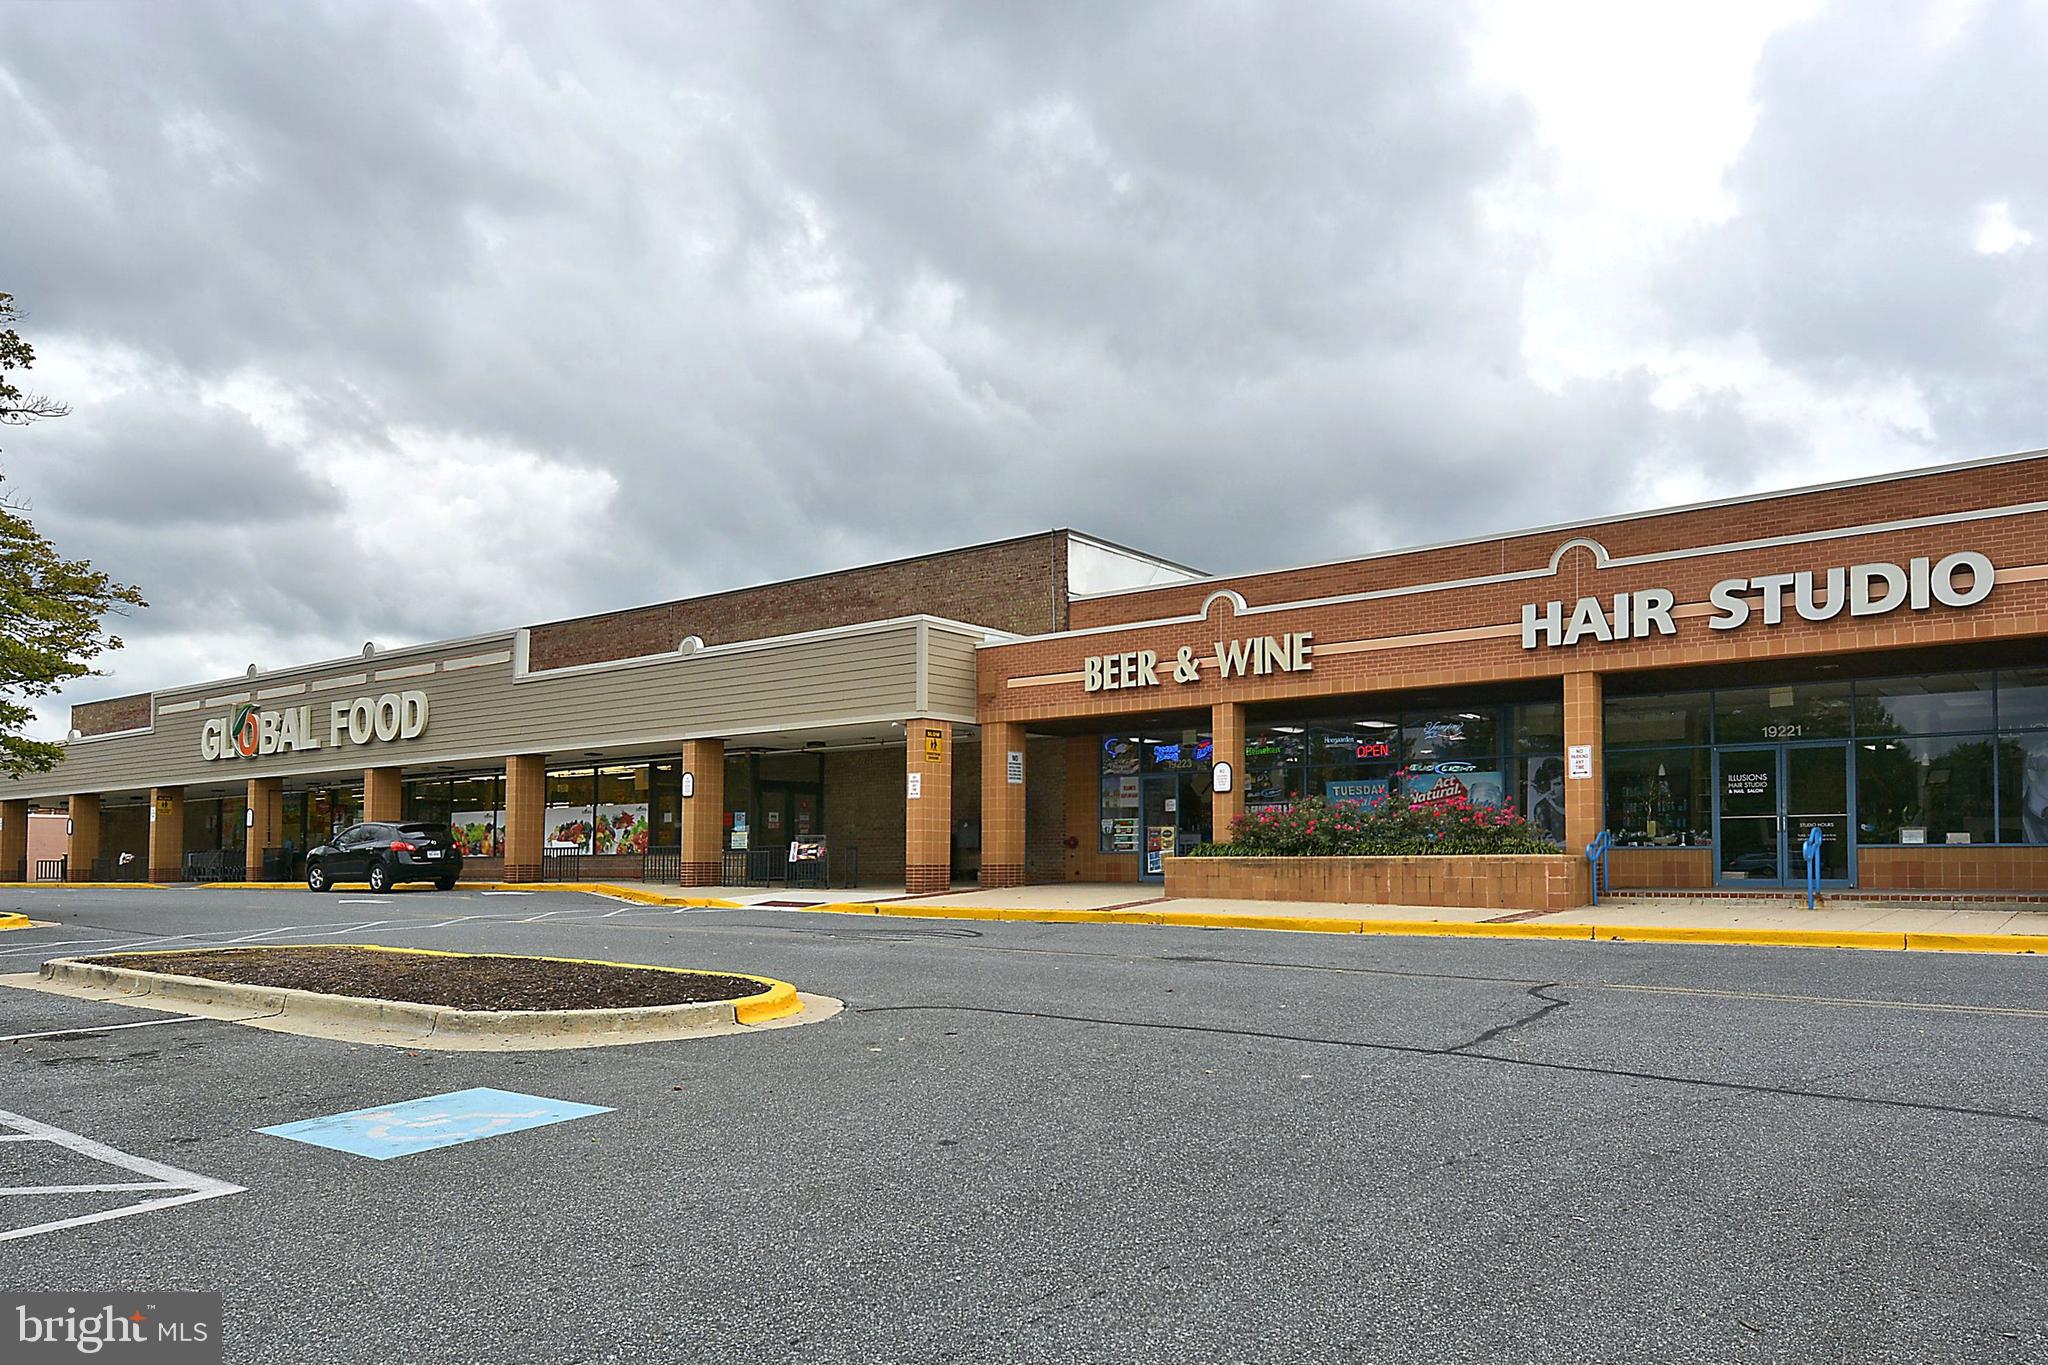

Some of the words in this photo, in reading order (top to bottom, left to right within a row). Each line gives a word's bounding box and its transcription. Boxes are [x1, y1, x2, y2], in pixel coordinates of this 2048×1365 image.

[1521, 588, 1677, 649] HAIR
[1709, 551, 1996, 629] STUDIO
[1084, 650, 1160, 692] BEER
[1173, 645, 1200, 684] &
[1214, 631, 1313, 678] WINE
[201, 703, 321, 761] GLOBAL
[330, 691, 429, 747] FOOD
[1761, 725, 1802, 737] 19221
[1356, 744, 1389, 758] OPEN
[1433, 775, 1456, 790] Act
[1728, 773, 1768, 781] ILLUSIONS
